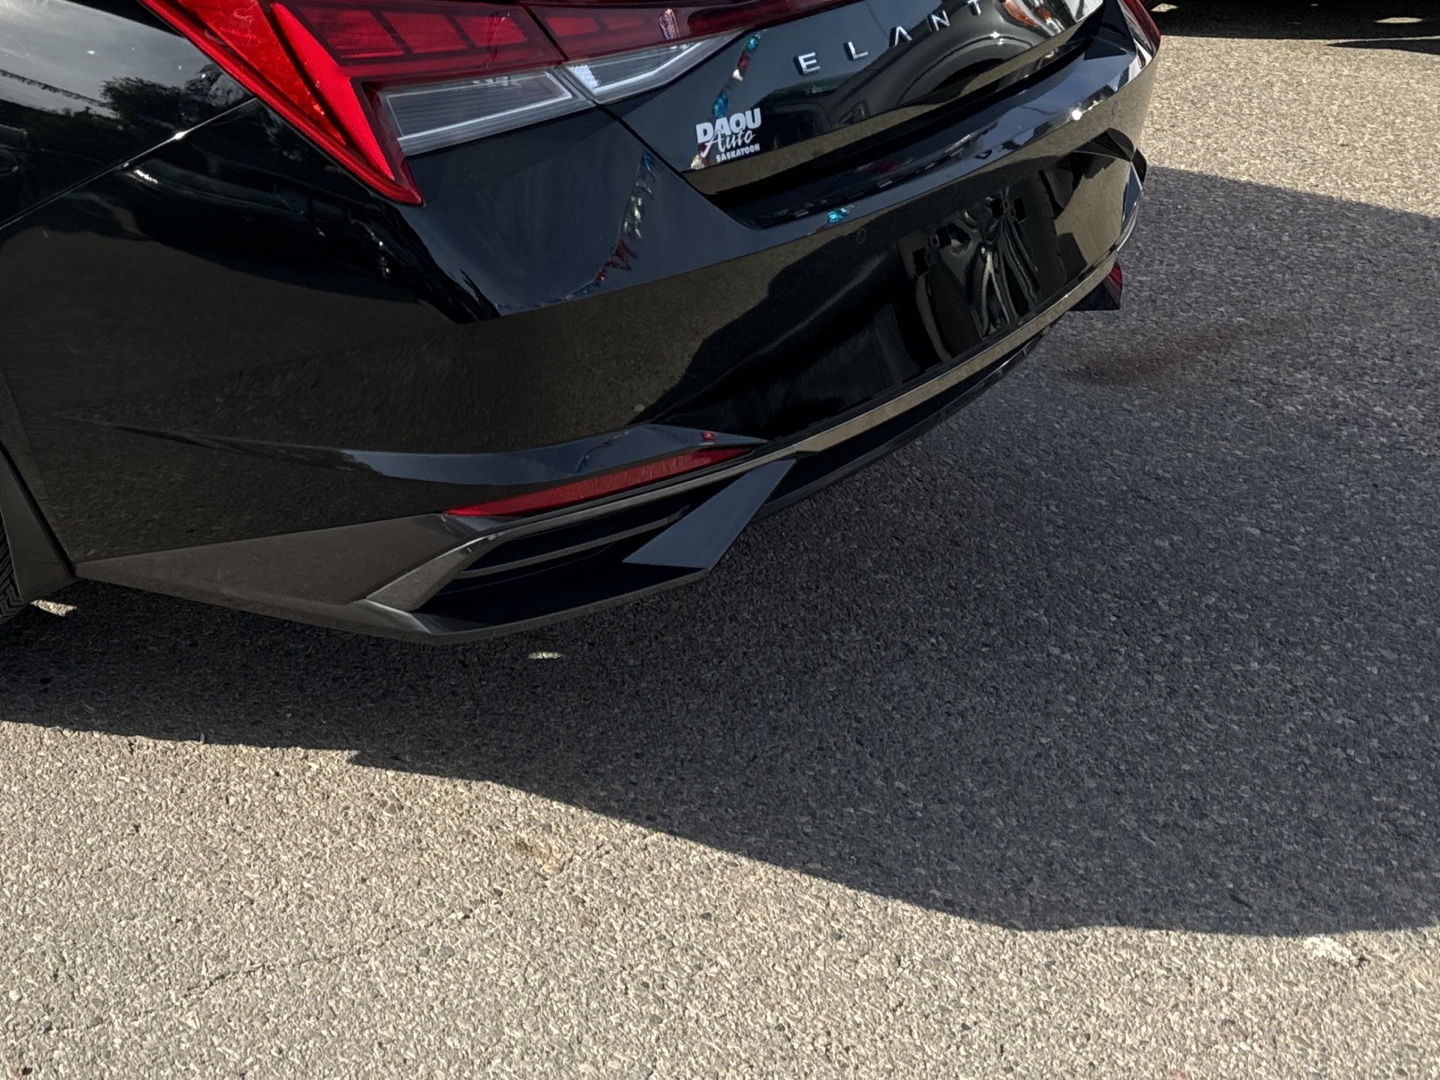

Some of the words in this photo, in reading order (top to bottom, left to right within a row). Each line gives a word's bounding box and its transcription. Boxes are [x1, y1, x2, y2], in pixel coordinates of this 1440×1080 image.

[695, 107, 762, 144] DAOU
[700, 128, 757, 159] Auto
[715, 143, 761, 163] SASKATOON
